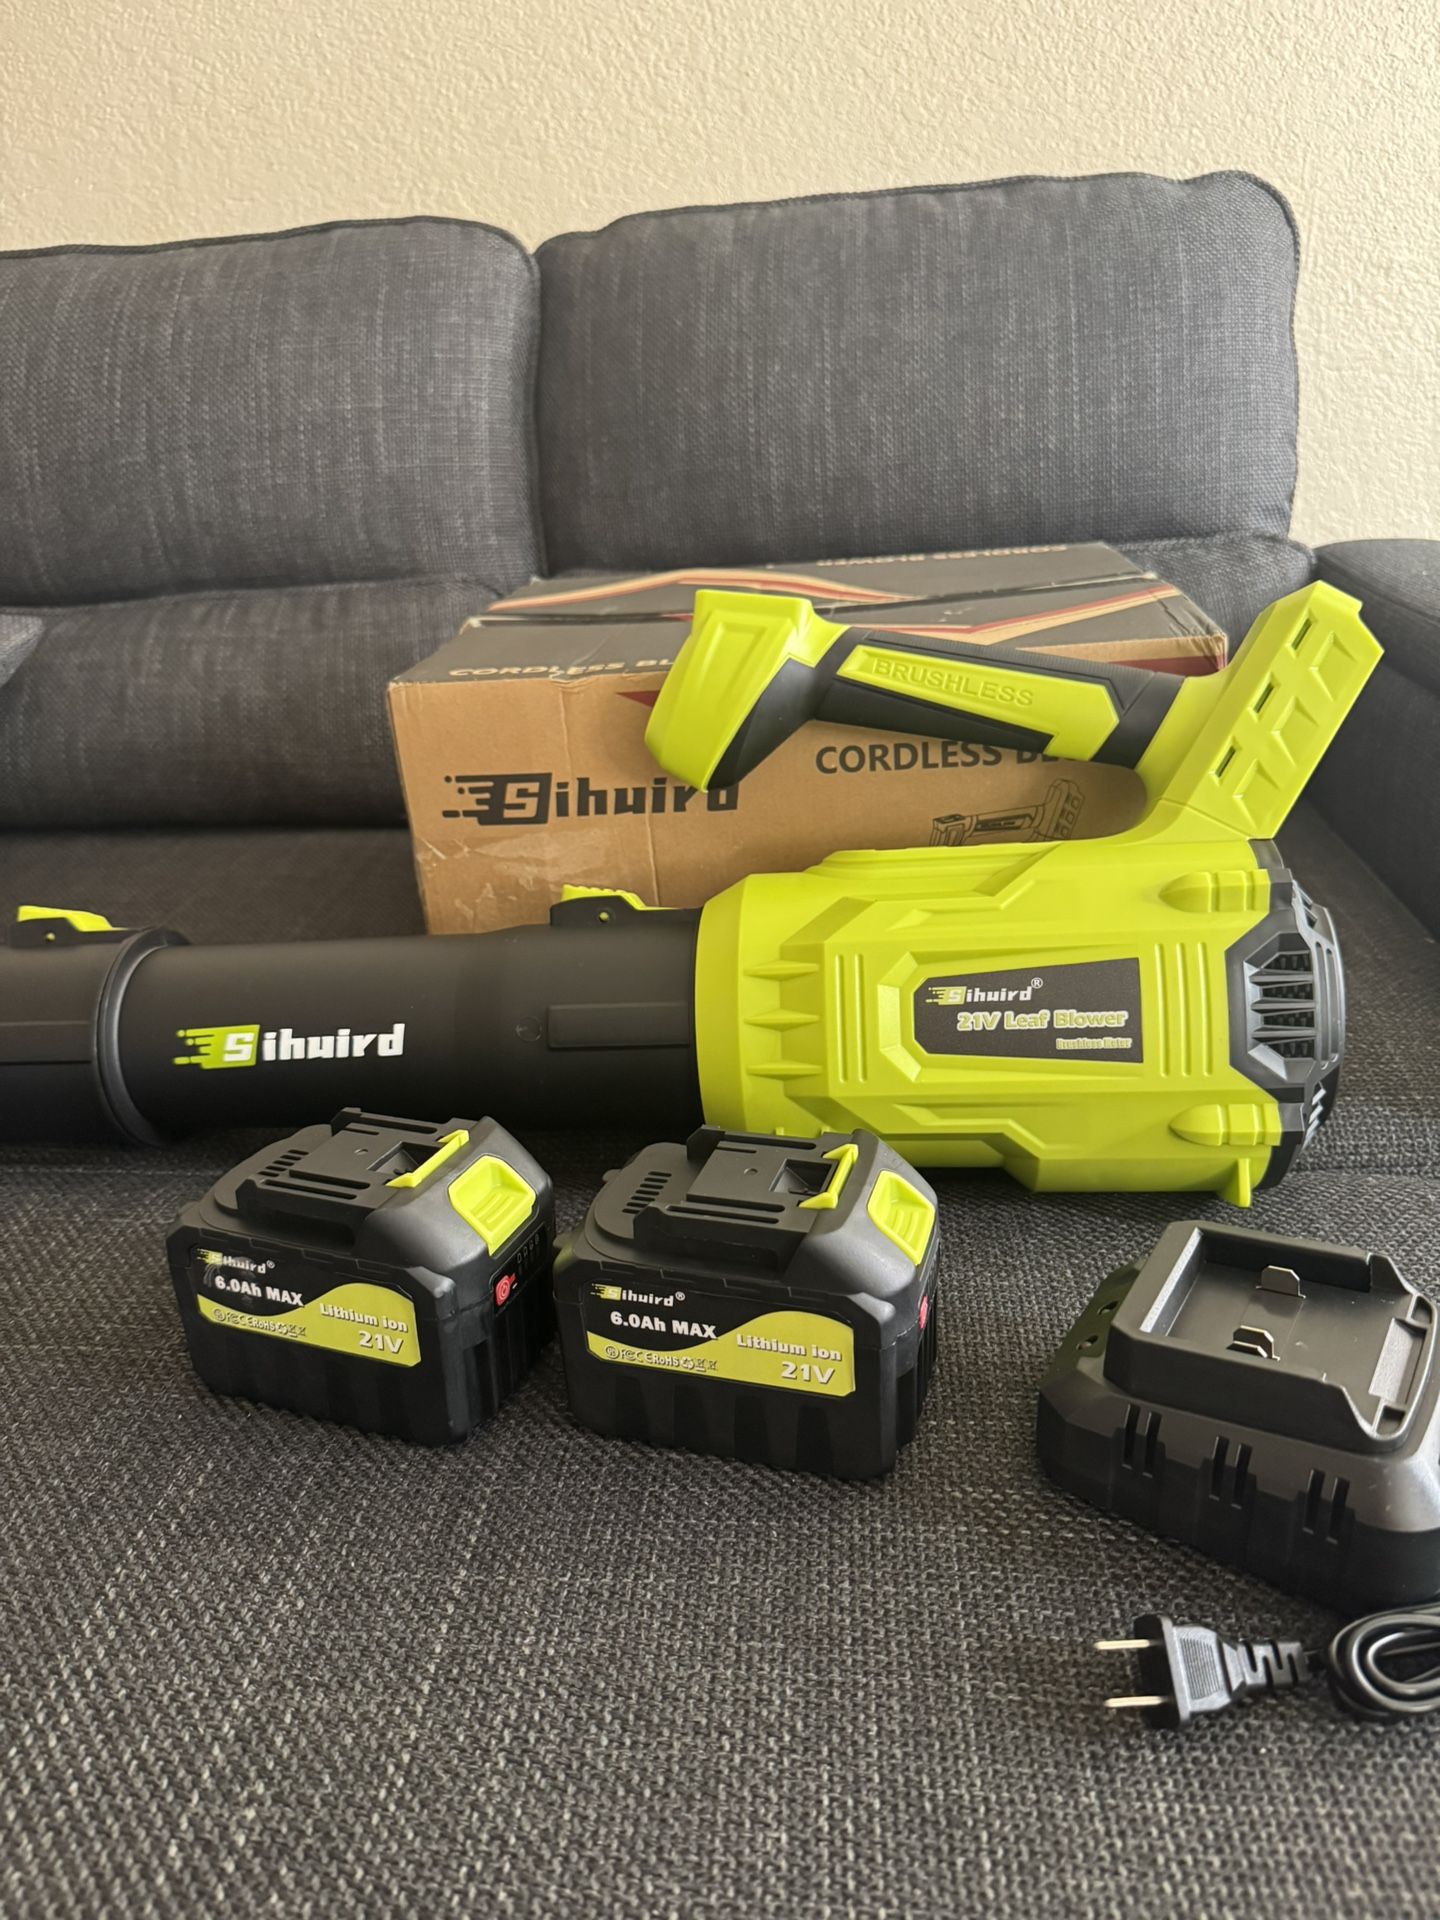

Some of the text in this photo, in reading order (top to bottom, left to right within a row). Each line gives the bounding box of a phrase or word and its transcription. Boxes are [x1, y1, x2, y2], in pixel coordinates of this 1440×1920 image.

[872, 657, 1035, 707] BRUSHLESS
[815, 740, 1002, 774] CORDLESS
[957, 1009, 1128, 1031] 21V Leaf Blower
[223, 1023, 405, 1063] Sihuird
[215, 1275, 304, 1306] 6.0Ah MAX
[319, 1303, 408, 1332] Lithium ion
[610, 1311, 718, 1340] 6.0Ah MAX
[358, 1331, 404, 1353] 21V
[736, 1334, 843, 1361] Lithium ion
[781, 1361, 836, 1384] 21V
